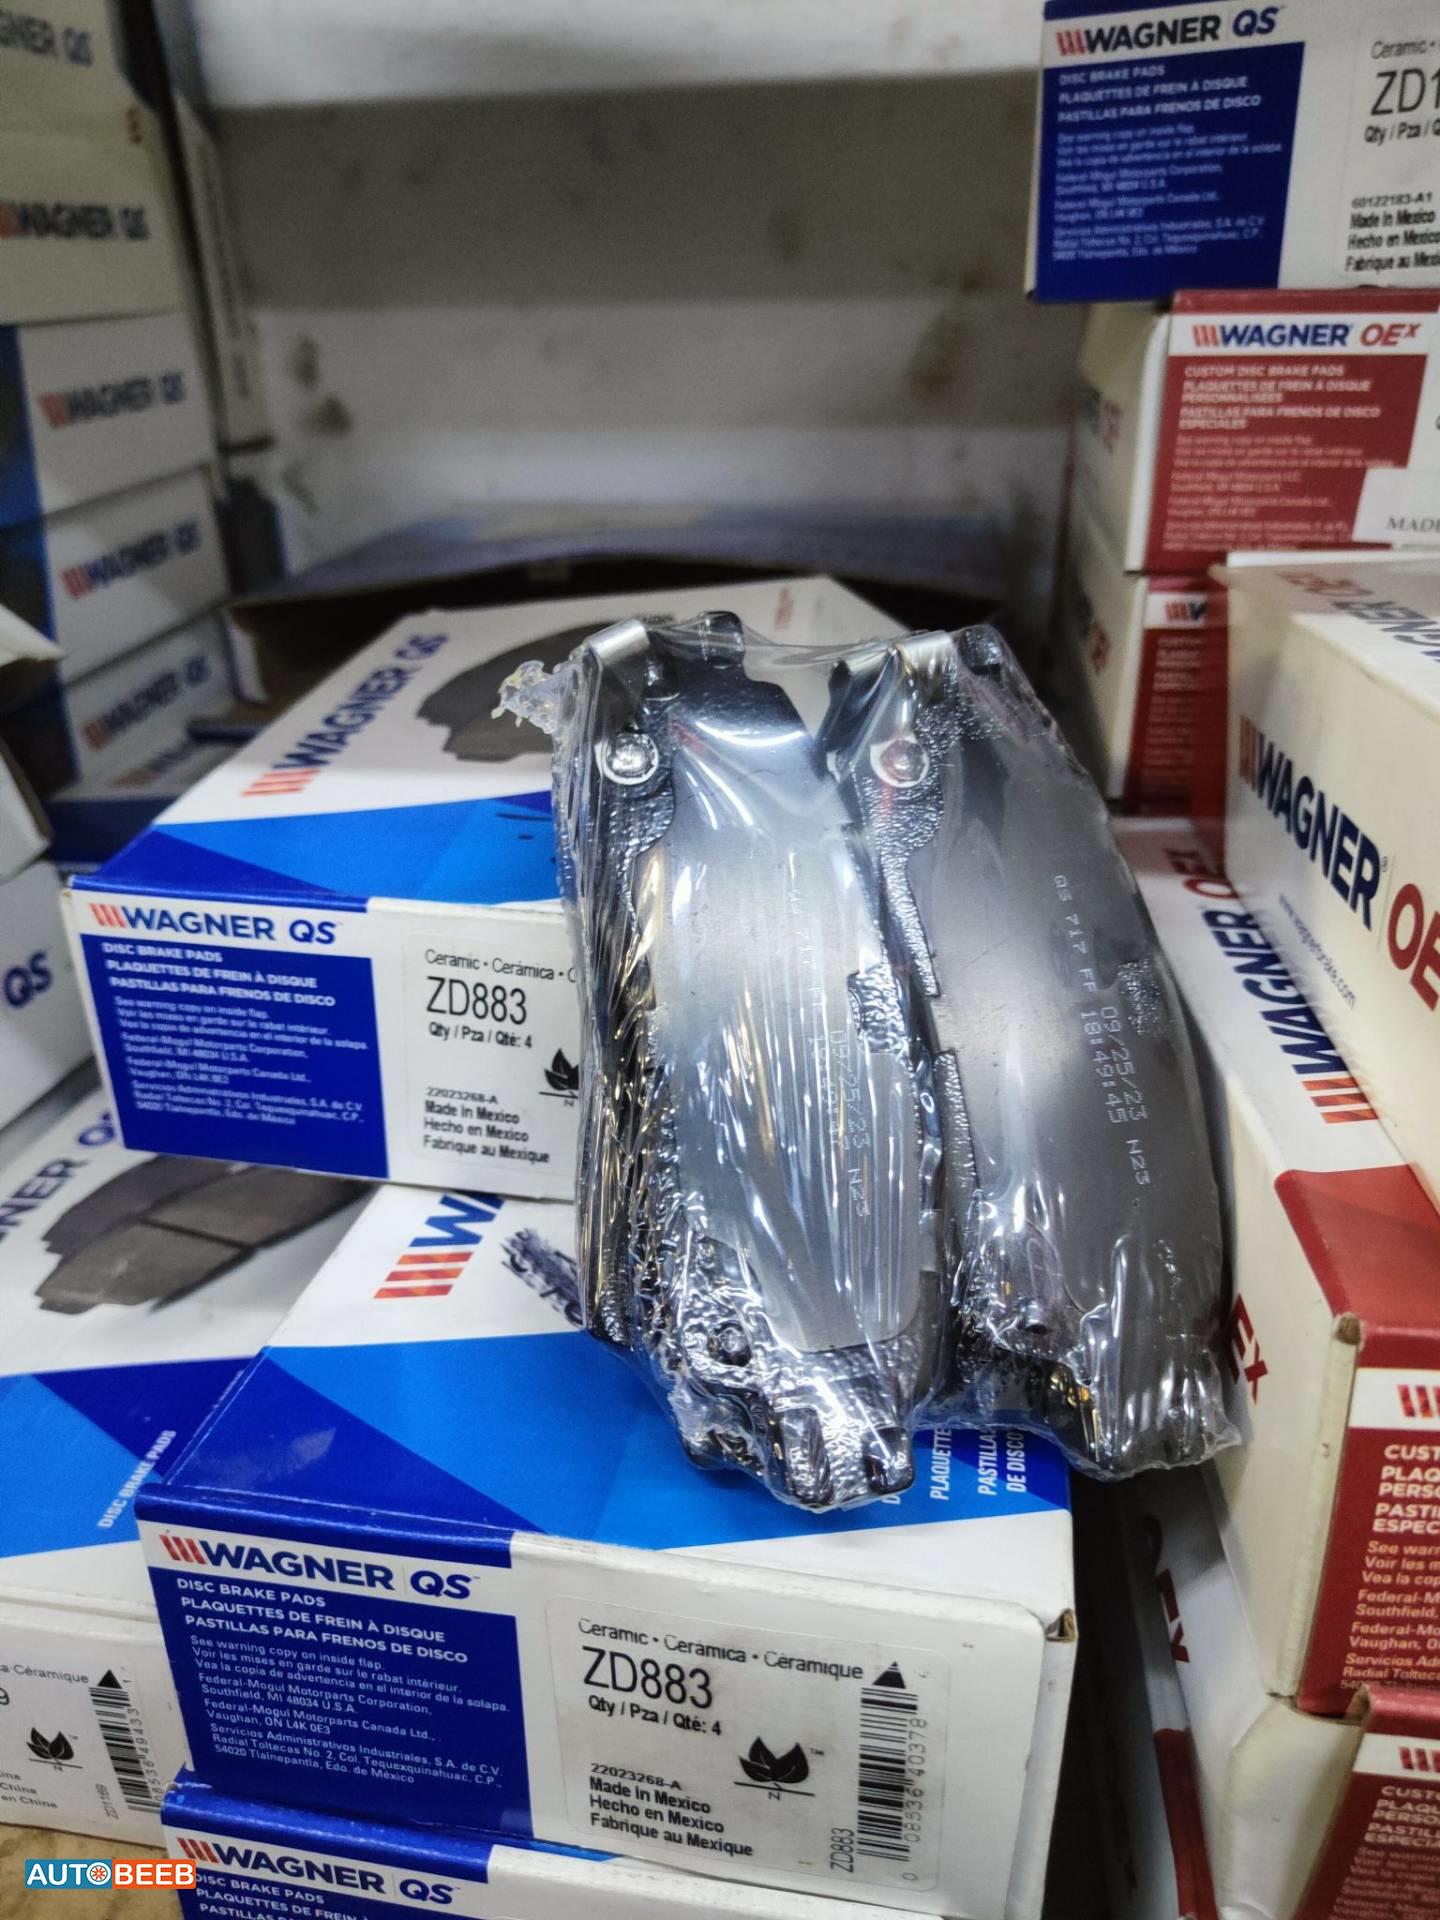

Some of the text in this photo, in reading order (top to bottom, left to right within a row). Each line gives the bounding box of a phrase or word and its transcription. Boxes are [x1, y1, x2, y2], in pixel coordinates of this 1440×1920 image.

[1084, 7, 1280, 54] WAGNER QS
[1219, 323, 1351, 347] WAGNER
[272, 667, 422, 770] WAGNER
[1257, 731, 1381, 932] WAGNER
[123, 906, 337, 946] WAGNER QS
[102, 942, 223, 963] DISC BRAKE PADS
[106, 959, 191, 977] PLAQUETTES
[193, 966, 211, 978] DE
[213, 968, 252, 982] FREIN
[266, 973, 318, 988] DISQUE
[425, 948, 480, 970] Ceramic
[109, 976, 336, 1007] PASTILLAS PARA FRENOS DE DISCO
[426, 976, 528, 1025] ZD883
[1202, 908, 1350, 1075] WAGNER
[429, 1021, 450, 1041] Qty
[462, 1026, 484, 1042] Pza
[524, 1035, 533, 1049] 4
[424, 1101, 457, 1117] Made
[477, 1107, 520, 1125] Mexico
[424, 1117, 529, 1142] Hecho en Mexico
[423, 1135, 550, 1165] Fabrique au Mexique
[97, 1430, 177, 1528] DISC BRAKE PADS
[977, 1429, 998, 1496] PASTILLA
[1006, 1431, 1027, 1493] DE DISCO
[1367, 1540, 1399, 1555] See
[200, 1539, 472, 1600] WAGNER QS
[177, 1578, 326, 1607] DISC BRAKE PADS
[181, 1597, 445, 1642] PLAQUETTES DE FREIN À DISQUE
[185, 1615, 468, 1663] PASTILLAS PARA FRENOS DE DISCO
[190, 1635, 385, 1670] See warning copy on inside flap.
[192, 1646, 462, 1693] Voir les mises en garde sur le rabat intérieur.
[578, 1617, 649, 1645] Ceramic
[764, 1650, 863, 1681] Céramique
[14, 1665, 89, 1684] Céramique
[195, 1658, 510, 1712] Vea la copia de advertencia en el interior de la solapa.
[198, 1672, 432, 1715] Federal-Mogul Motorparts Corporation,
[582, 1645, 712, 1709] ZD883
[204, 1698, 290, 1717] Federal-Mogul
[293, 1710, 358, 1728] Motorparts
[362, 1720, 406, 1736] Canada
[588, 1694, 722, 1736] Qty Pza Qté: 4
[210, 1723, 263, 1738] Servicios
[266, 1730, 355, 1752] Administrativos
[359, 1744, 432, 1765] Industriales,
[461, 1762, 476, 1772] de
[908, 1717, 928, 1777] 40378
[589, 1776, 631, 1798] Made
[654, 1790, 712, 1814] Mexico
[591, 1763, 683, 1791] 22023268-A
[590, 1794, 724, 1833] Hecho en Mexico
[591, 1812, 753, 1857] Fabrique au Mexique
[830, 1828, 855, 1873] ZD883
[212, 1843, 453, 1904] WAGNER QS
[230, 1878, 324, 1904] BRAKE PADS
